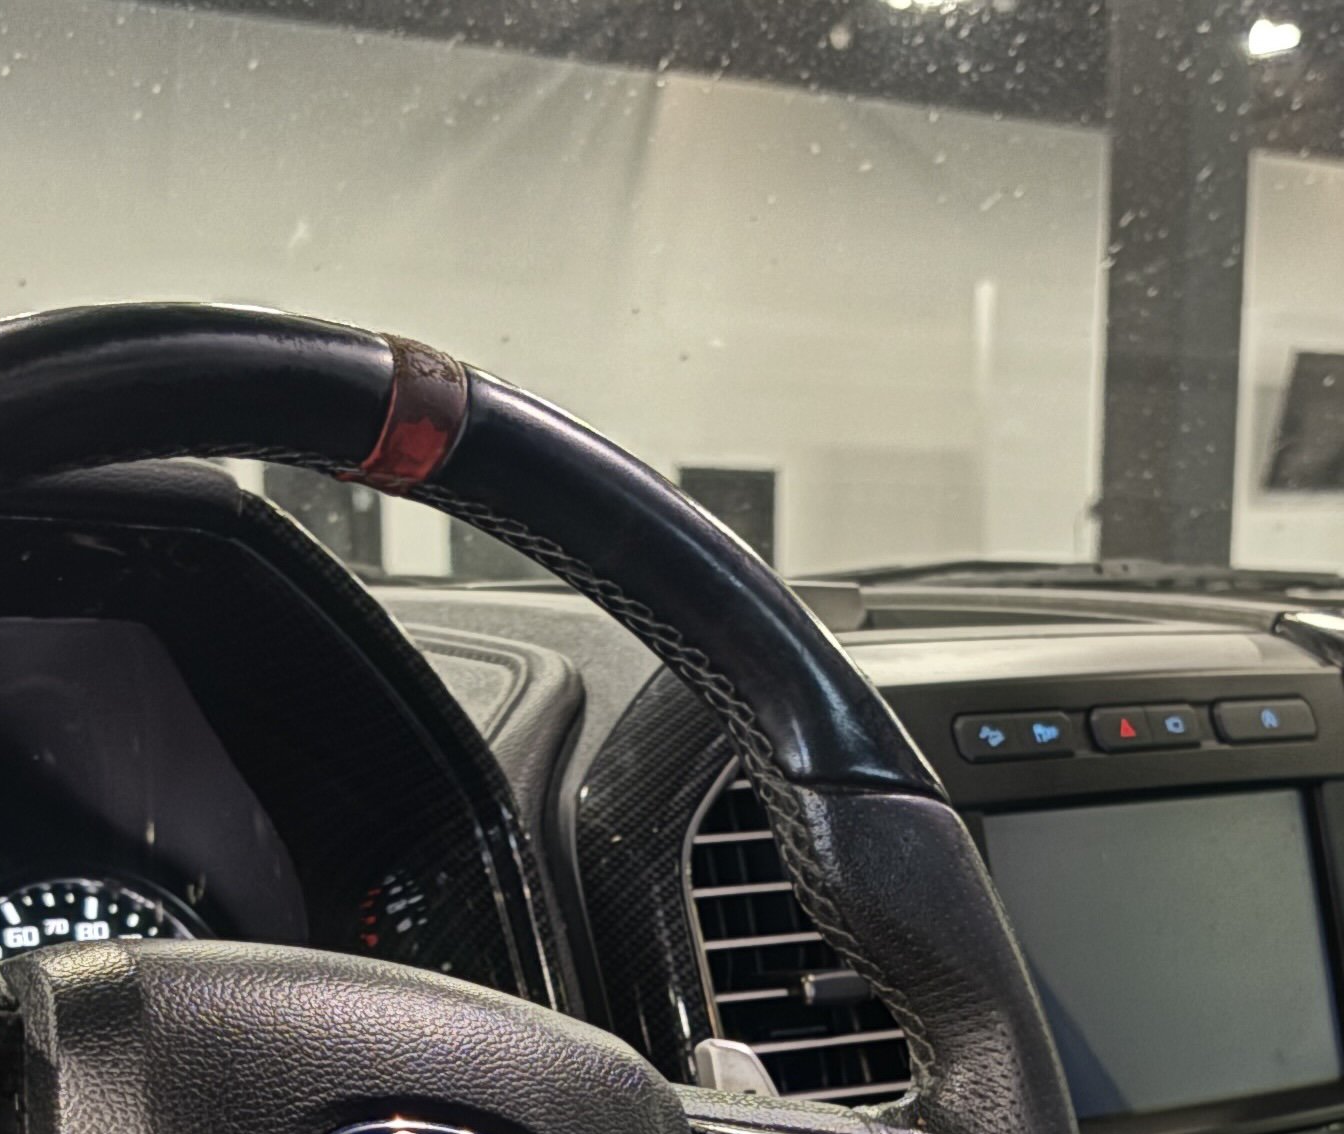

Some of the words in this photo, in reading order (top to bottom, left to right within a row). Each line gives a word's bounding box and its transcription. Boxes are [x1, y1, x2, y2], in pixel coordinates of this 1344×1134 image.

[43, 918, 69, 935] 70
[75, 921, 109, 941] 80
[3, 926, 39, 948] 60
